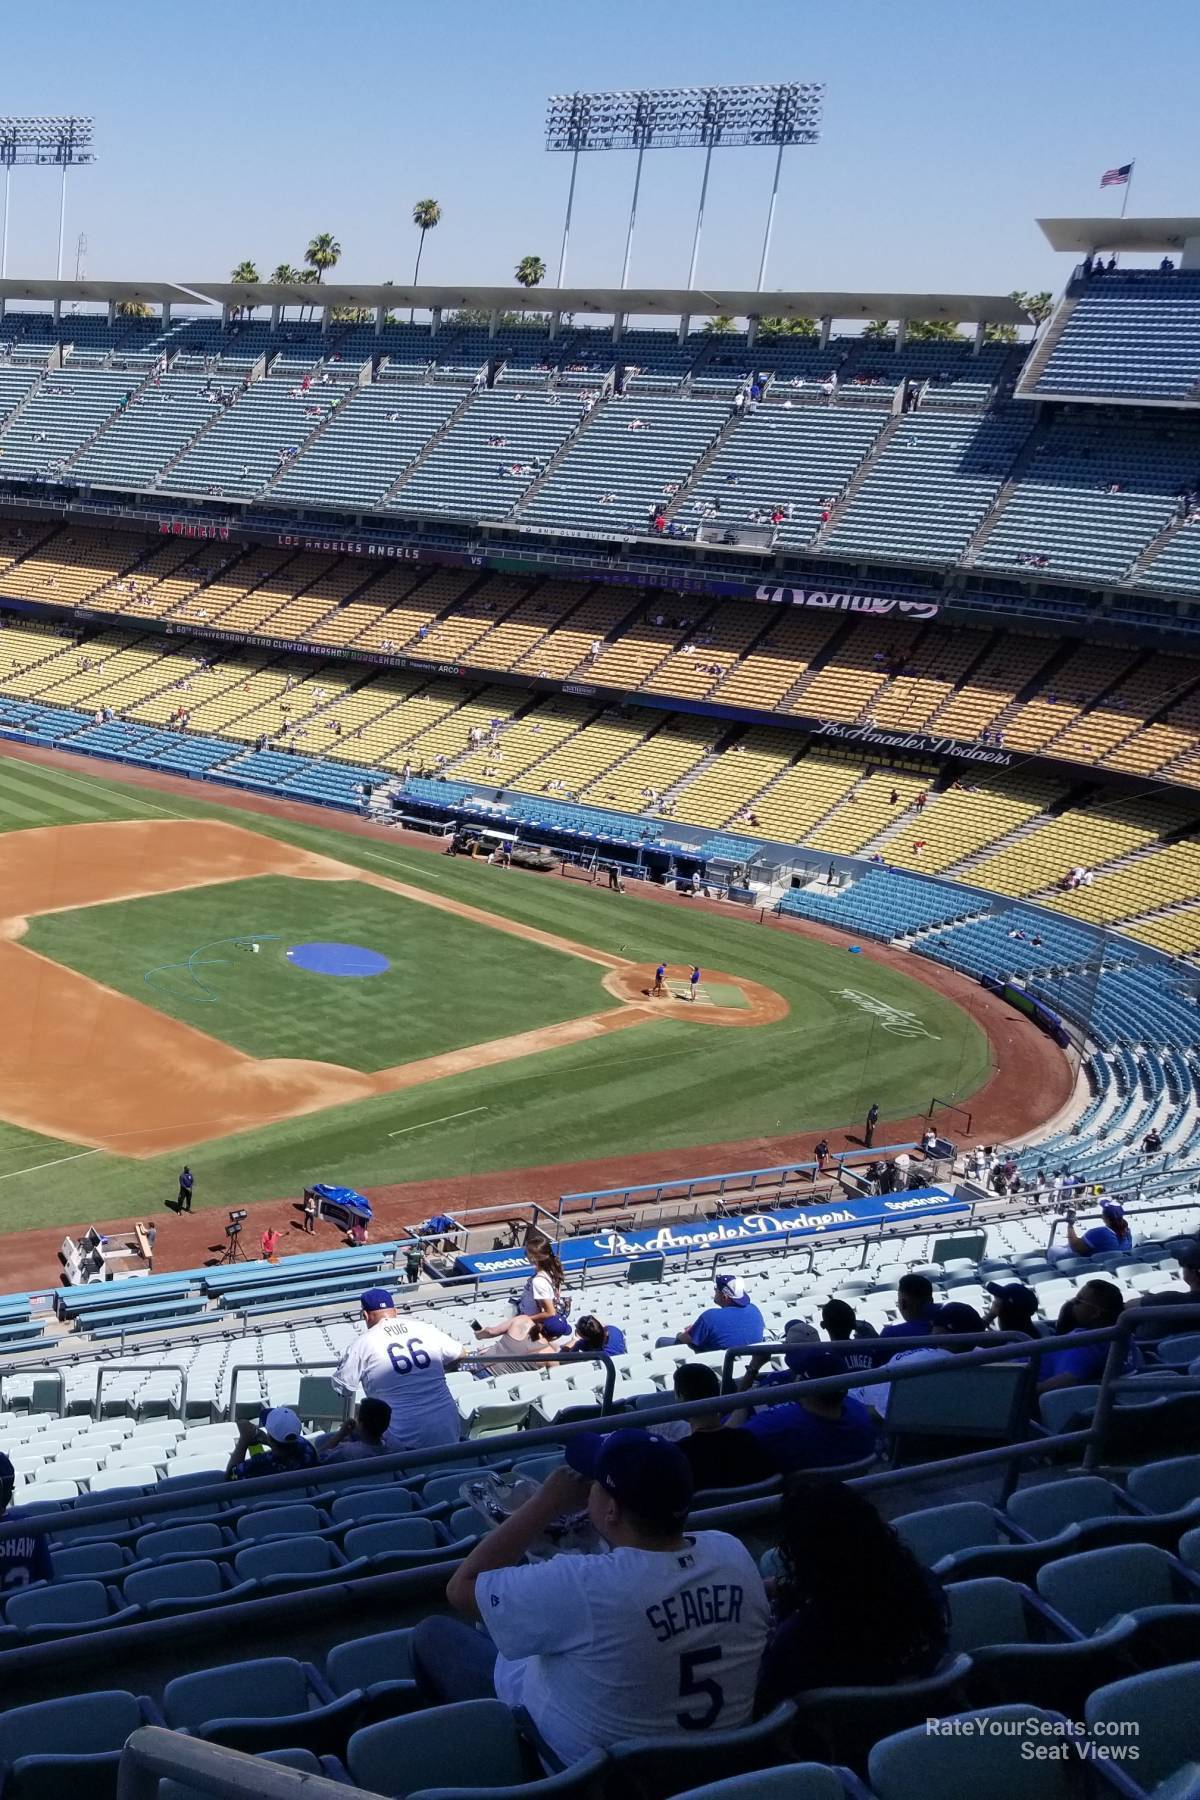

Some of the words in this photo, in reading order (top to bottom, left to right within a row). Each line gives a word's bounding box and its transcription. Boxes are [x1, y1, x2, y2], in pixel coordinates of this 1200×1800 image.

[278, 535, 299, 546] LOS
[305, 538, 362, 553] ANGELES
[368, 544, 419, 559] ANGELS
[192, 628, 245, 643] ANNIVERSARY
[246, 636, 271, 647] RETRO
[272, 641, 308, 653] CLAYTON
[310, 645, 349, 659] KERSHAW
[438, 665, 459, 675] ARCO
[811, 718, 844, 736] Los
[843, 725, 925, 751] Angeles
[927, 735, 1012, 766] Dodgers
[884, 1196, 950, 1211] Spectrum
[594, 1229, 648, 1259] Los
[646, 1227, 745, 1251] Angeles
[743, 1210, 857, 1234] Dodgers
[474, 1257, 530, 1273] Spectru
[383, 1323, 409, 1337] PUIG
[387, 1337, 432, 1375] 66
[646, 1584, 744, 1643] SEAGER
[676, 1645, 724, 1731] 5
